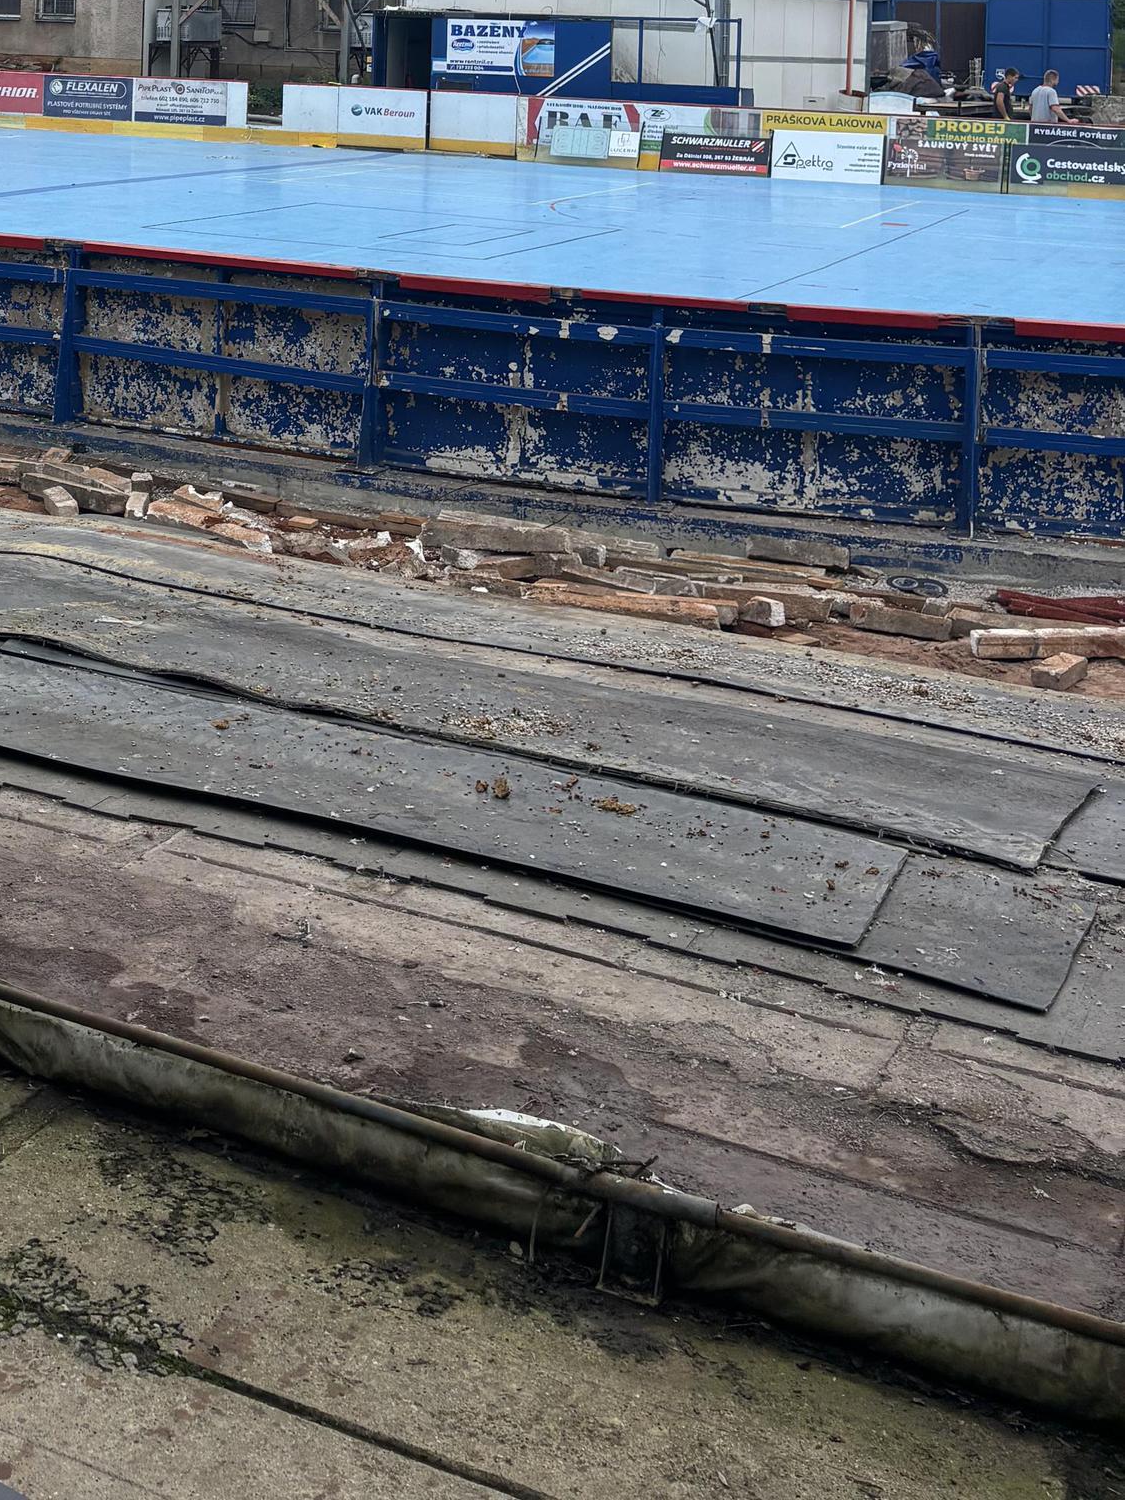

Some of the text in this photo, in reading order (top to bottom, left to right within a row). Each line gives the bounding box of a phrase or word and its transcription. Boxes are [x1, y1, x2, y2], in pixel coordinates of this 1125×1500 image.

[451, 22, 526, 38] BAZÉNY
[65, 81, 118, 93] FLEXALEN
[154, 114, 205, 123] www.pipeplast.cz
[364, 107, 415, 118] VAK Beroun
[766, 114, 883, 130] PRÁŠKOVÁ LAKOVNA
[935, 120, 1006, 135] PRODEJ
[1034, 128, 1118, 141] RYBÁŘSKÉ POTŘEBY
[671, 136, 751, 149] SCHWARZMULLER
[918, 140, 997, 153] SAUNOVÝ SVĚT
[673, 161, 757, 172] www.schwarzmueller.cz
[783, 153, 834, 169] Spektra
[1046, 171, 1105, 183] obchod.cz
